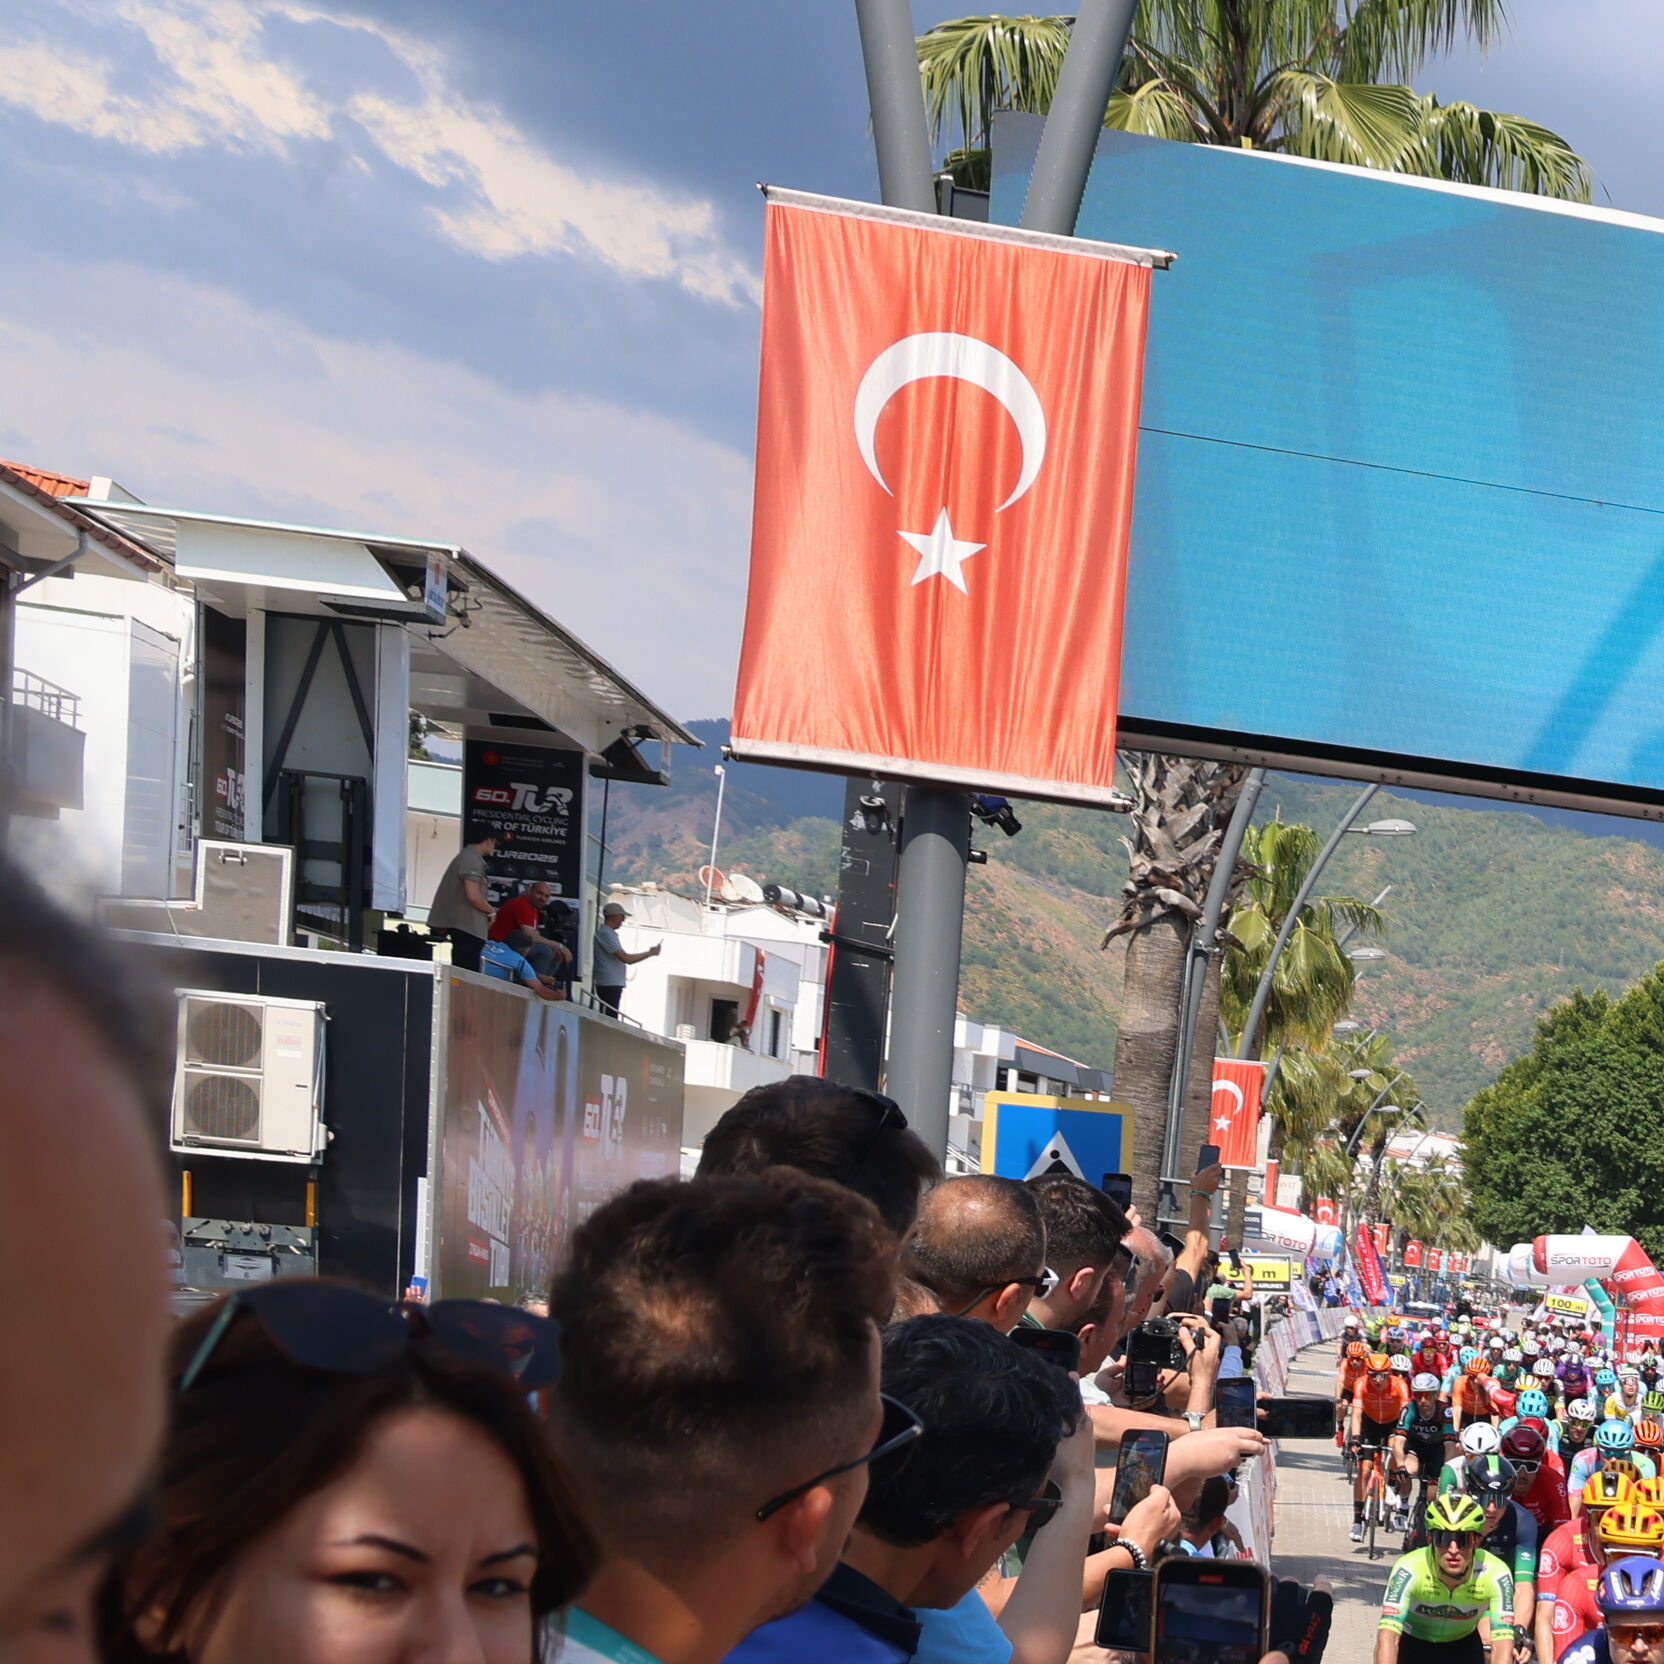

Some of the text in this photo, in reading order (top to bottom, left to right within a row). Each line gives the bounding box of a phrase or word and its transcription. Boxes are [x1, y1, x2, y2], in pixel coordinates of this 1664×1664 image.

[510, 782, 574, 816] TUR
[472, 808, 569, 826] PRESIDENTIAL CYCLING
[503, 821, 519, 831] OF
[520, 821, 568, 837] TÜRKİYE
[1550, 1298, 1572, 1309] 100
